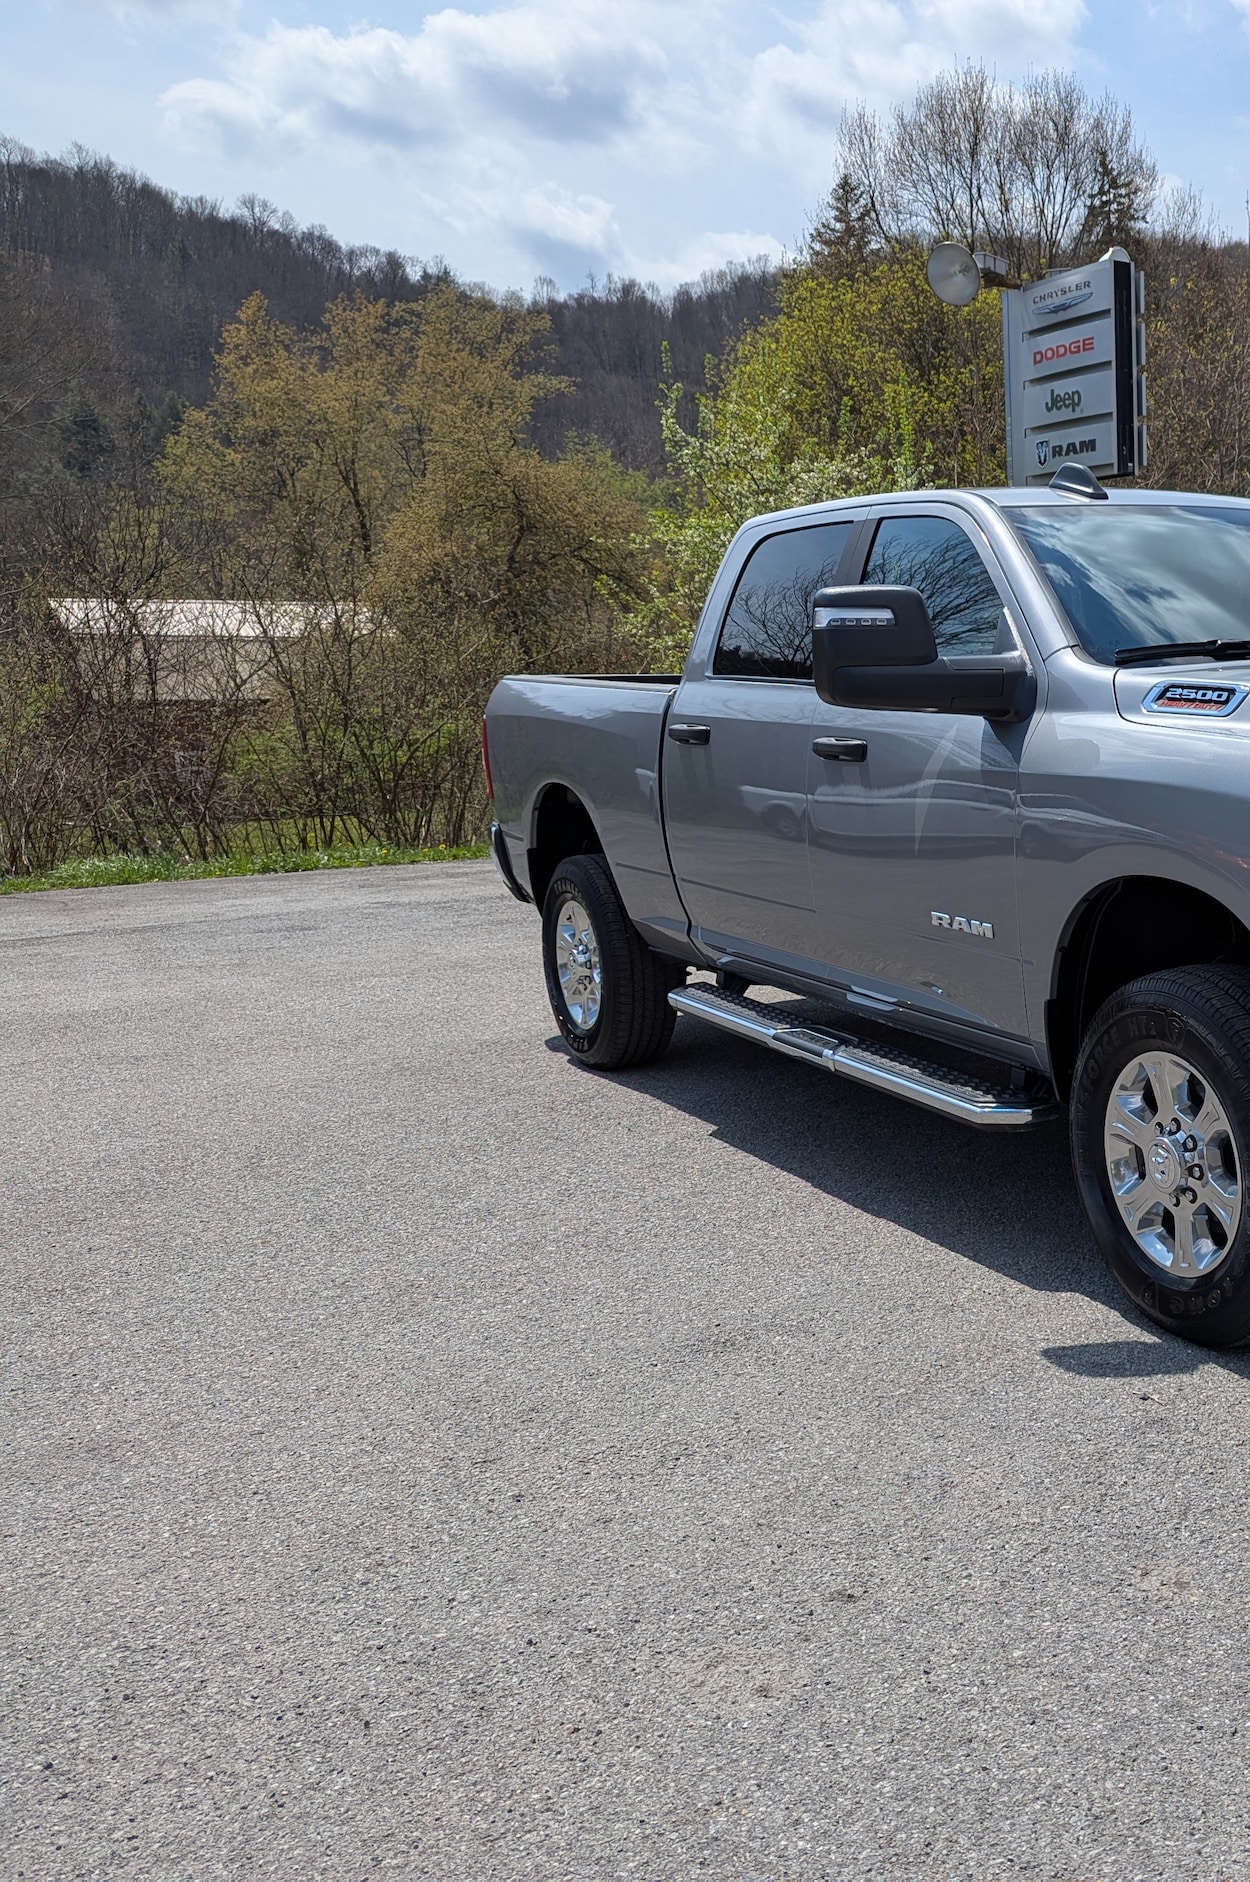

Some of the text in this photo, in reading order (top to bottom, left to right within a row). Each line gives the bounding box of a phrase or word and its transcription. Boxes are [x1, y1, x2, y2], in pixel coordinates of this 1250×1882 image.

[1032, 280, 1092, 305] CHRYSLER
[1033, 336, 1095, 366] DODGE
[1045, 388, 1082, 413] Jeep
[1051, 438, 1097, 459] RAM
[1165, 687, 1229, 702] 2500
[931, 911, 994, 939] RAM
